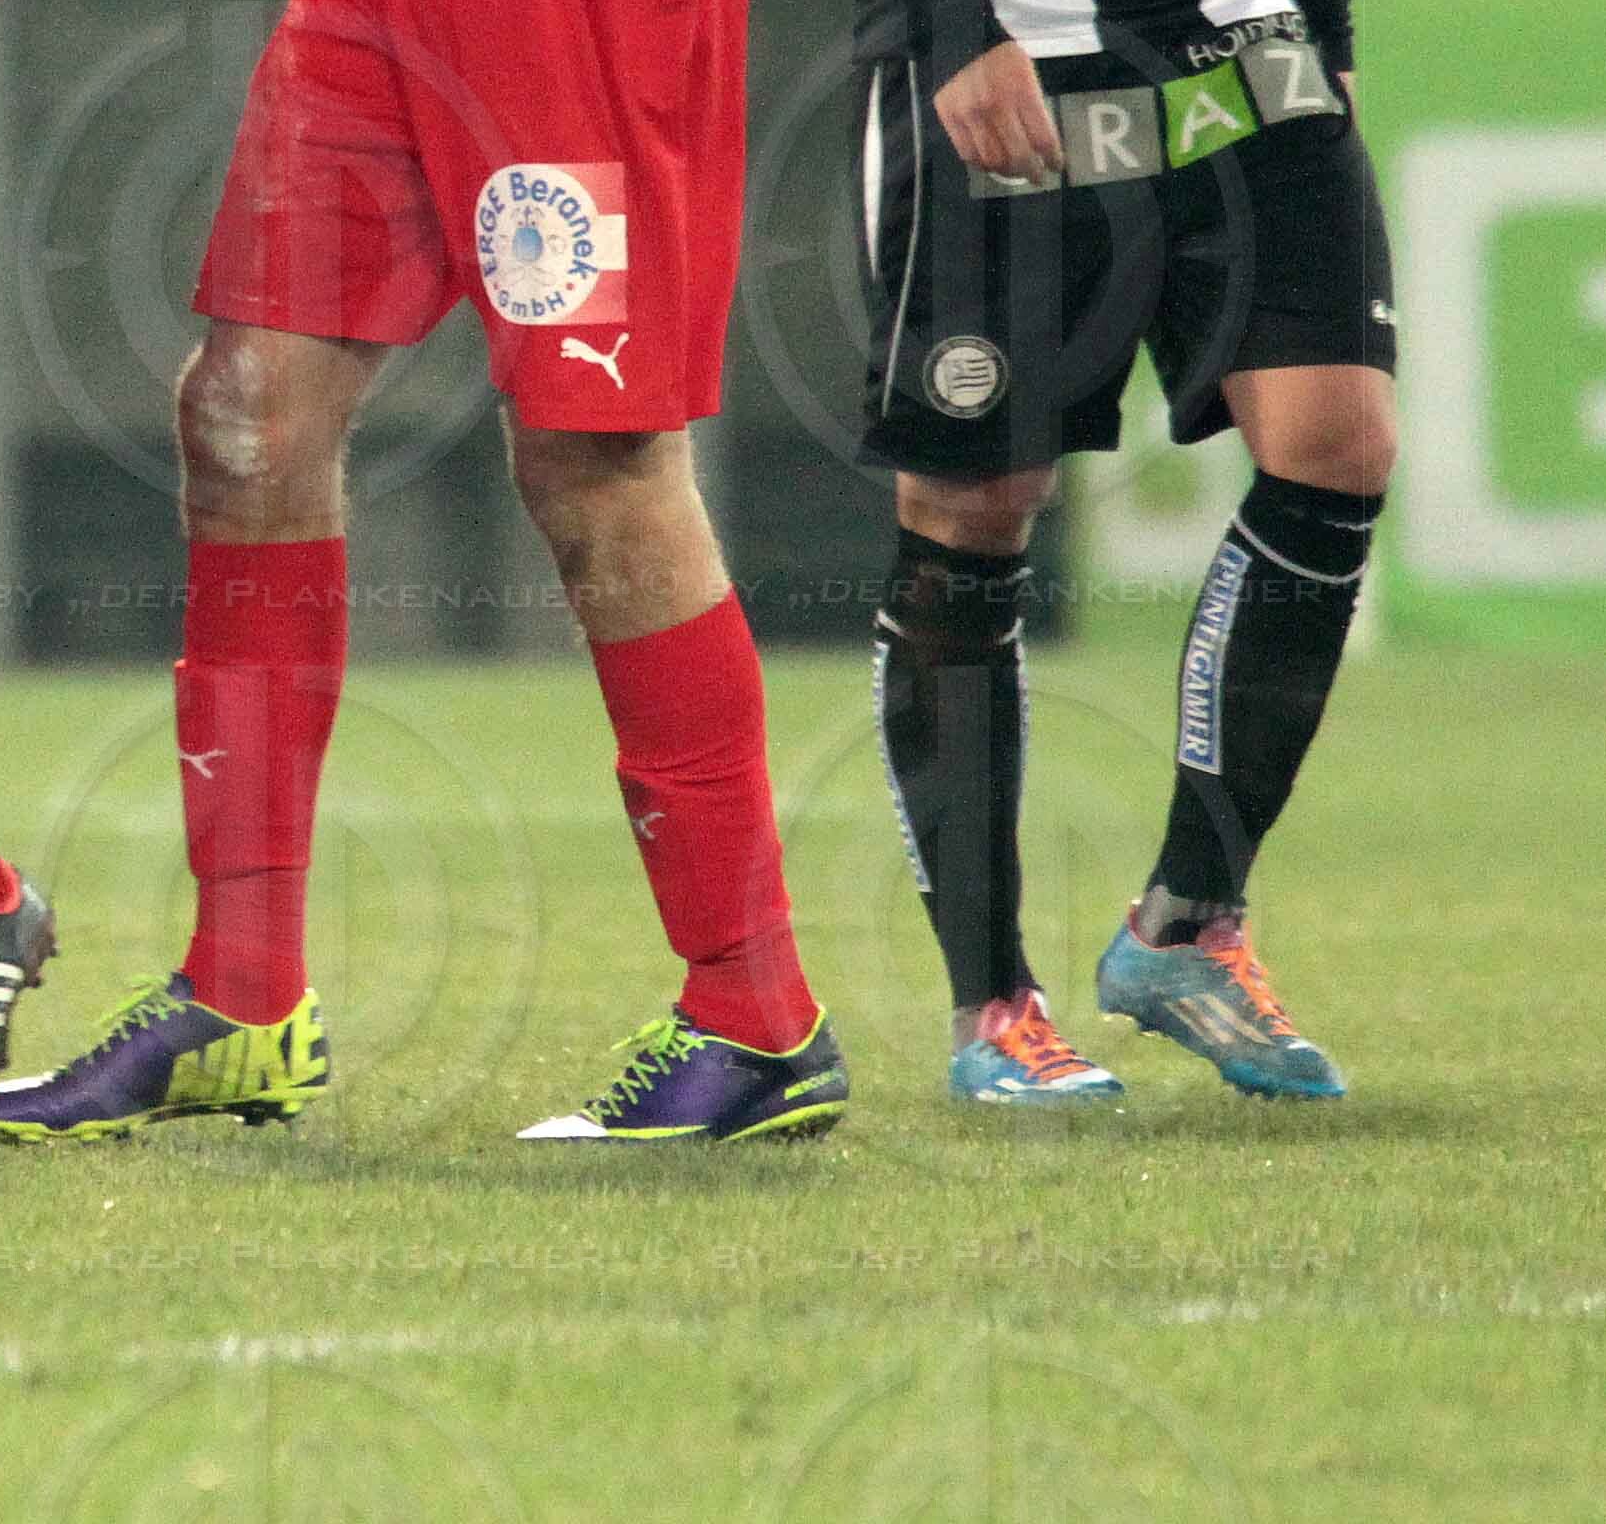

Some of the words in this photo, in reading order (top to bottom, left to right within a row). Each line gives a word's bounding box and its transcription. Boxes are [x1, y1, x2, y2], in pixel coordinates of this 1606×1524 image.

[985, 48, 1325, 188] RAZ
[479, 186, 506, 278] ERGE
[508, 171, 599, 279] Beranek
[497, 290, 566, 318] GmbH
[164, 990, 328, 1103] NIKE
